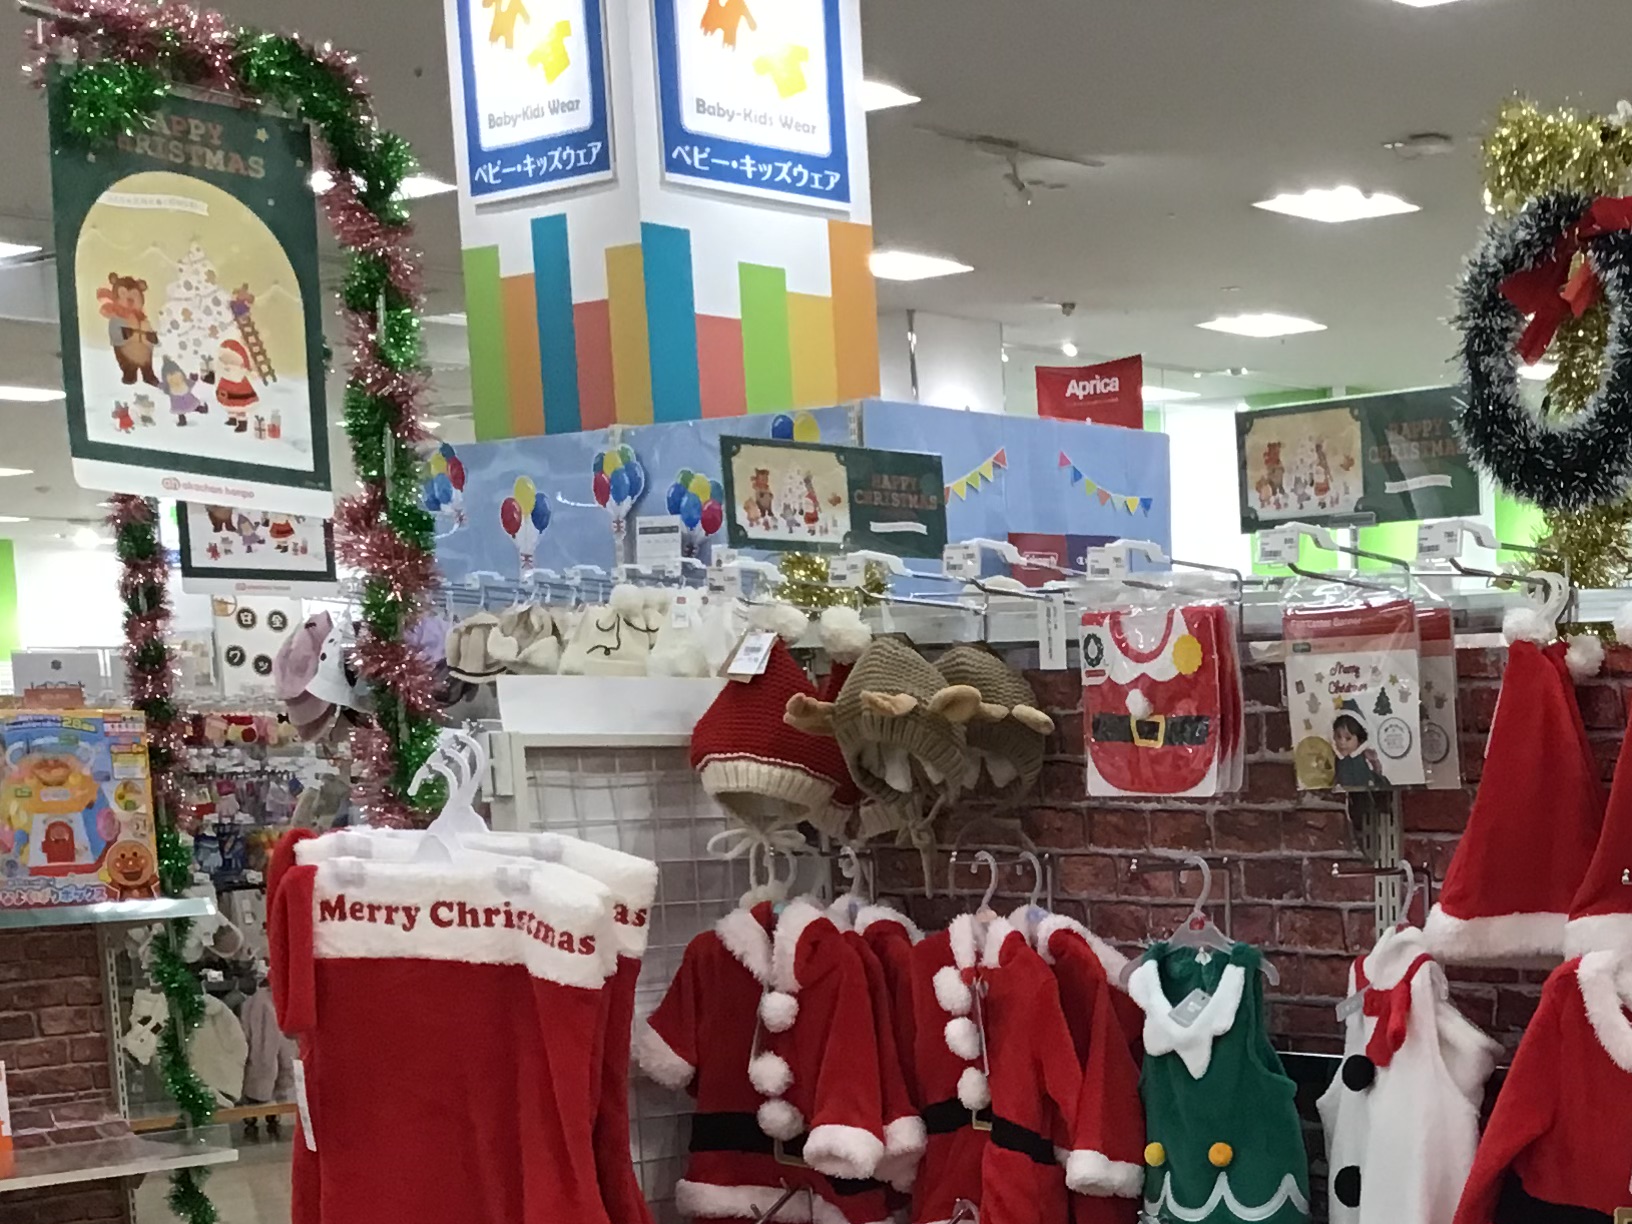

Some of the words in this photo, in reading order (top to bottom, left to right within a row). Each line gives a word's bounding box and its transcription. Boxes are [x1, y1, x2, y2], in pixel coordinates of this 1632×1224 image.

[548, 98, 581, 116] Wear
[695, 97, 773, 127] Baby-Kids
[779, 114, 817, 135] Wear
[150, 110, 223, 146] APPY
[474, 141, 602, 184] ベビー・キッズウェア
[671, 144, 841, 191] ベビー・キッズウェア
[1065, 374, 1119, 400] Aprica
[318, 893, 421, 932] Merry
